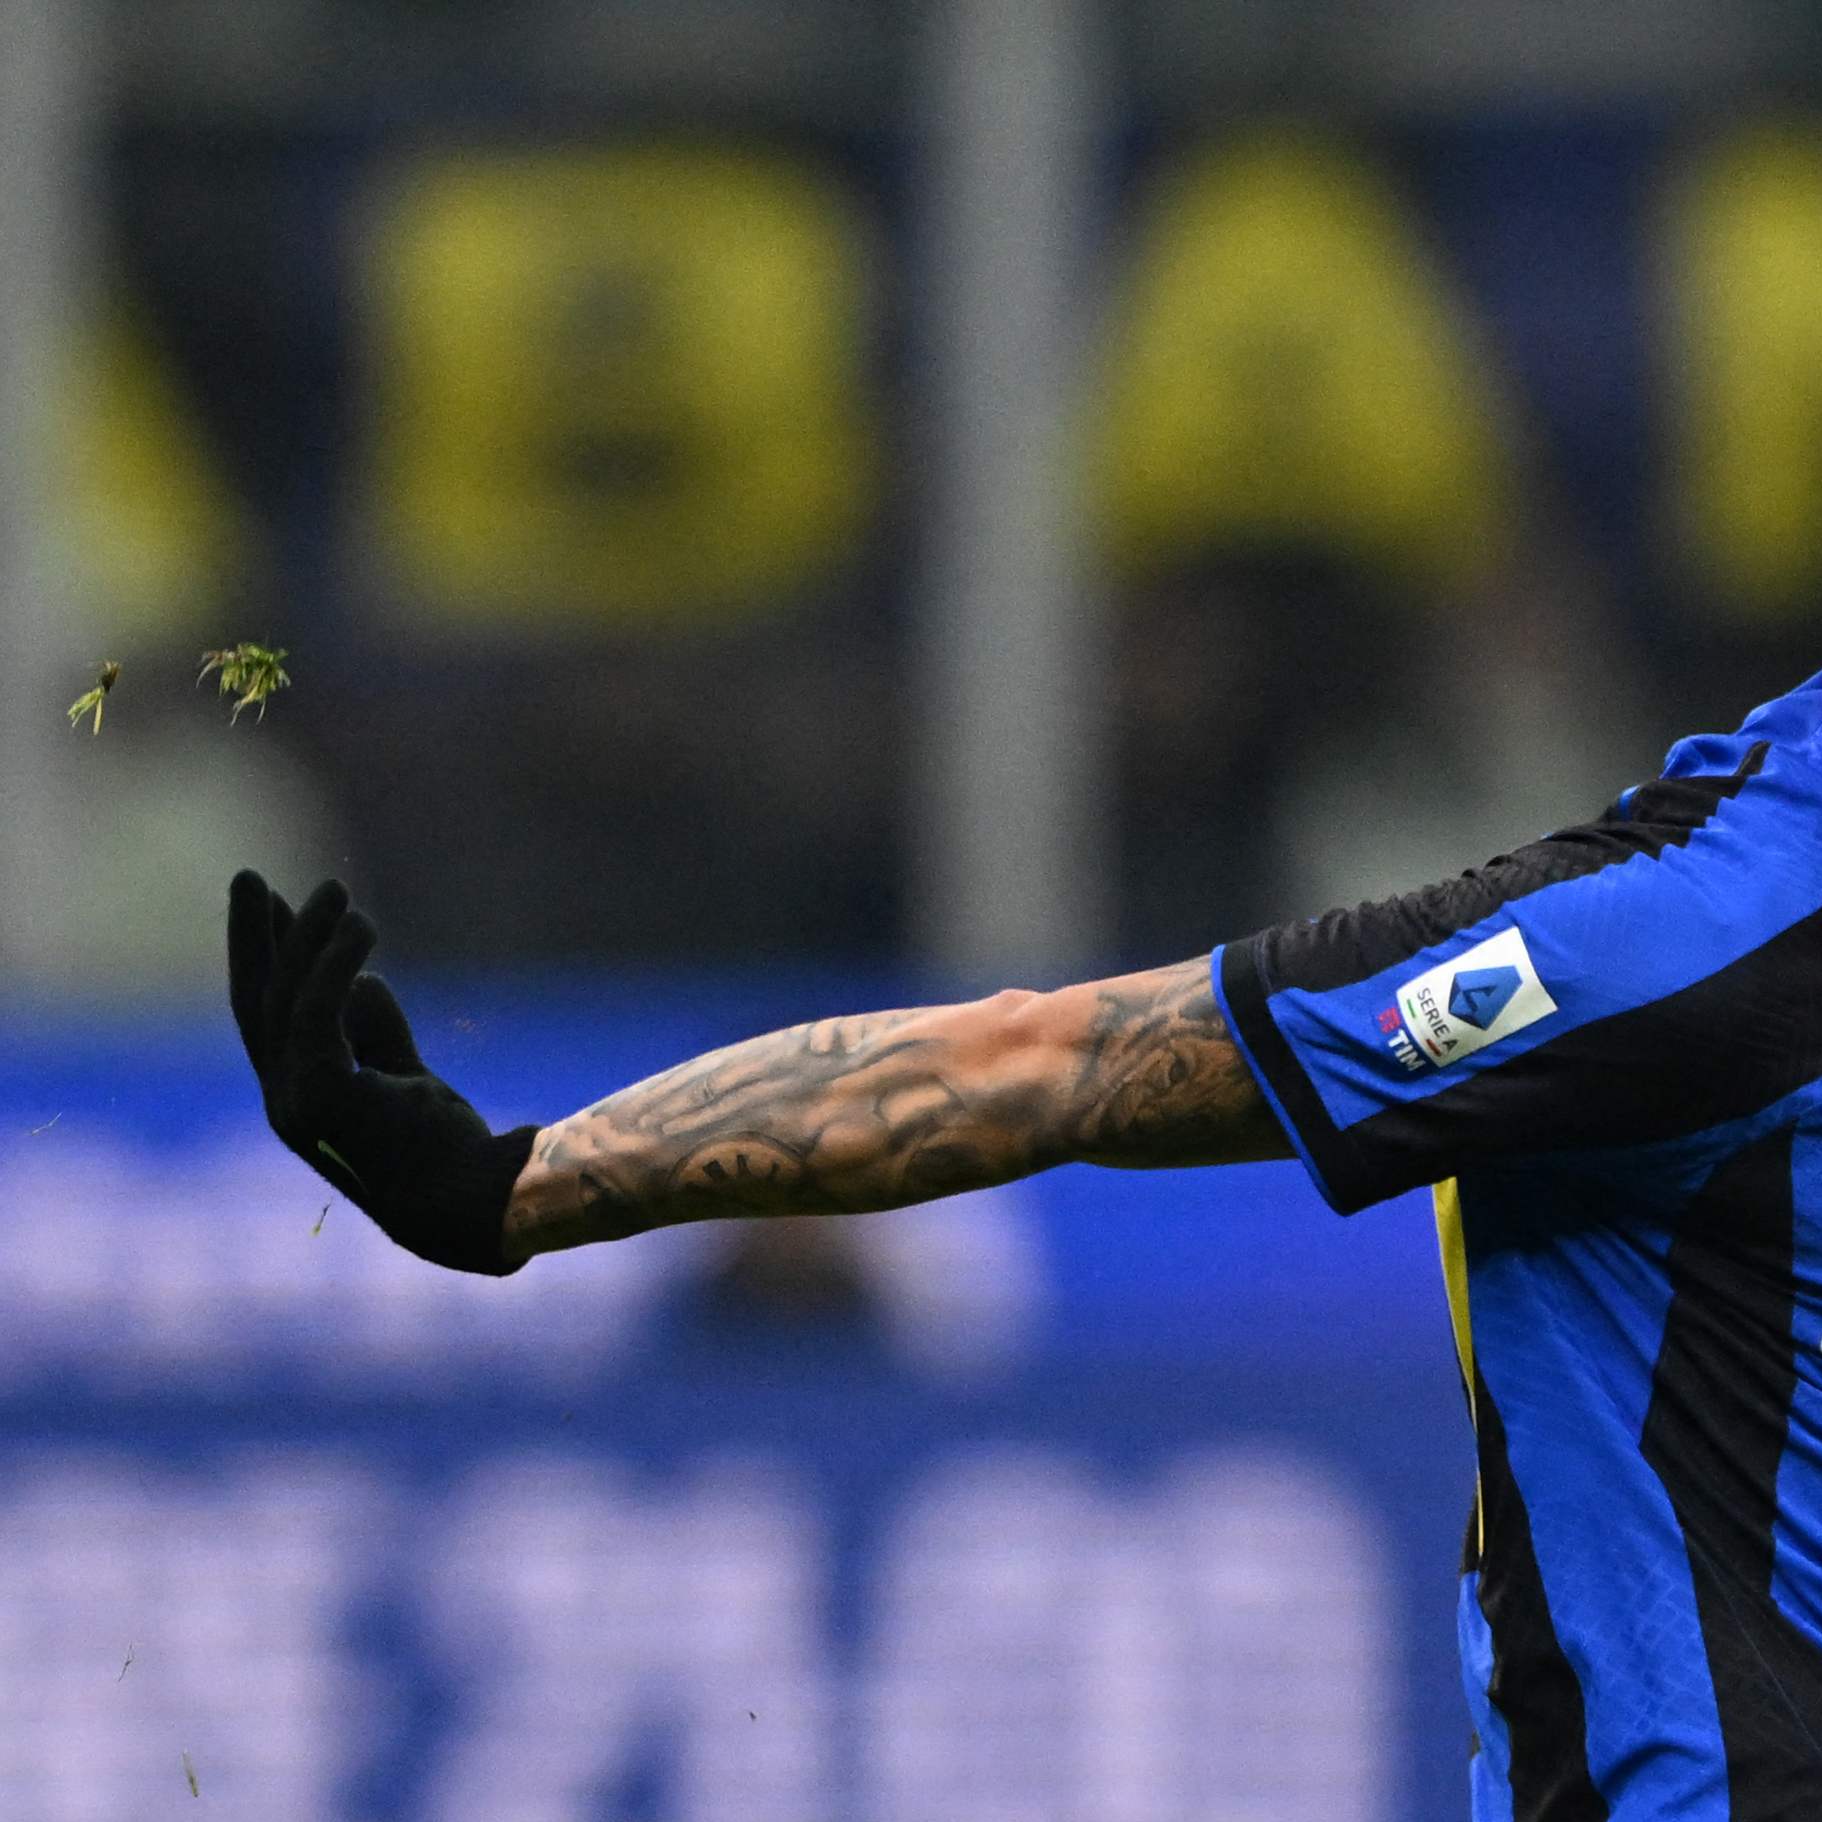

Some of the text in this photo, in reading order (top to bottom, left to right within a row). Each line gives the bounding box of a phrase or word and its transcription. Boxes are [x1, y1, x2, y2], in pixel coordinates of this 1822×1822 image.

[1417, 987, 1459, 1051] SERIE A
[1388, 1029, 1426, 1071] TIM
